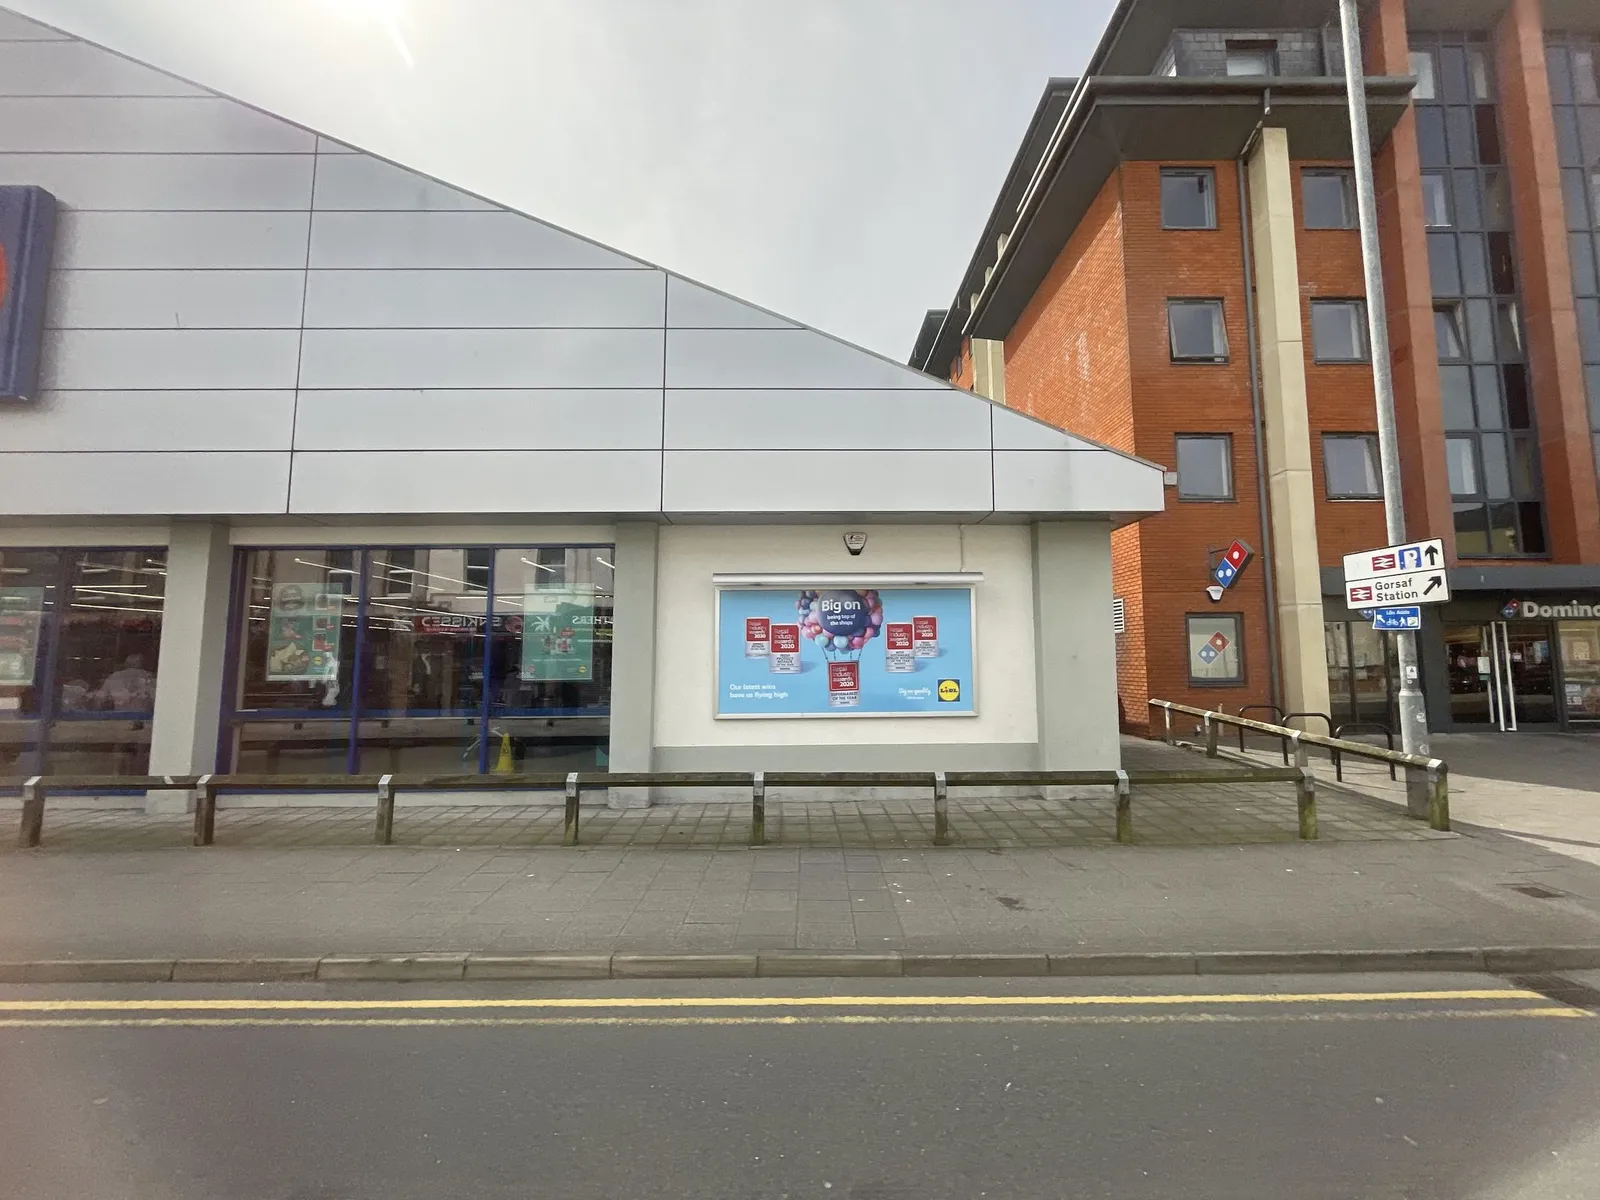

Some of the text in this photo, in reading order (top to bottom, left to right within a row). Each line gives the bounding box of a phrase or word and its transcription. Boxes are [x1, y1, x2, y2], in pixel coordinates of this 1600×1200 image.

[1375, 578, 1412, 590] Gorsaf
[1376, 591, 1418, 602] Station
[821, 599, 860, 614] Big on
